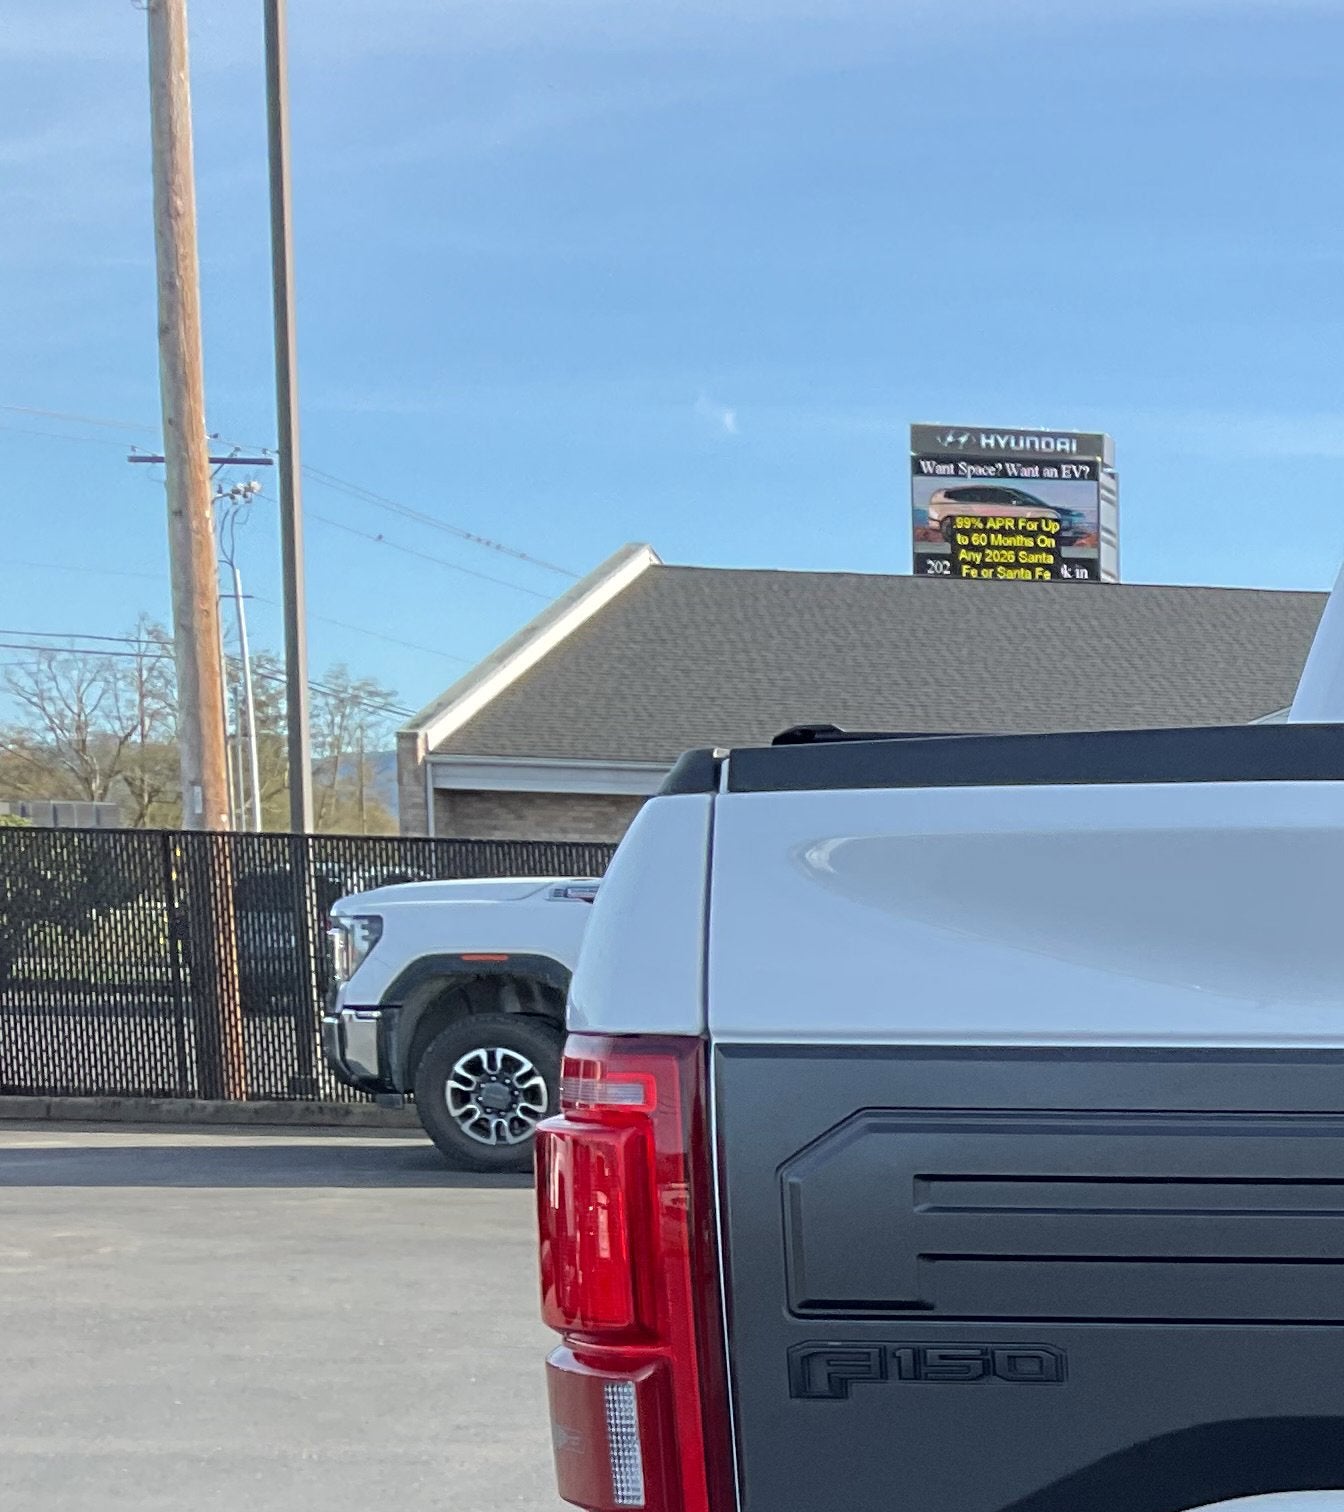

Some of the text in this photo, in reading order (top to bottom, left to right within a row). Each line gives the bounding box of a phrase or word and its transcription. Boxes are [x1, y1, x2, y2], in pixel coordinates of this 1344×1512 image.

[980, 433, 1078, 453] HYUNDAI
[919, 460, 1090, 479] Want Space? Want an EV?
[986, 517, 1015, 530] APR
[1018, 518, 1038, 530] For
[1041, 519, 1060, 533] Up
[956, 533, 1056, 548] to 60 Months On
[959, 549, 982, 564] Any
[1018, 551, 1054, 564] Santa
[962, 565, 978, 577] Fe
[981, 567, 994, 578] or
[997, 566, 1033, 579] Santa
[1035, 567, 1051, 580] Fe
